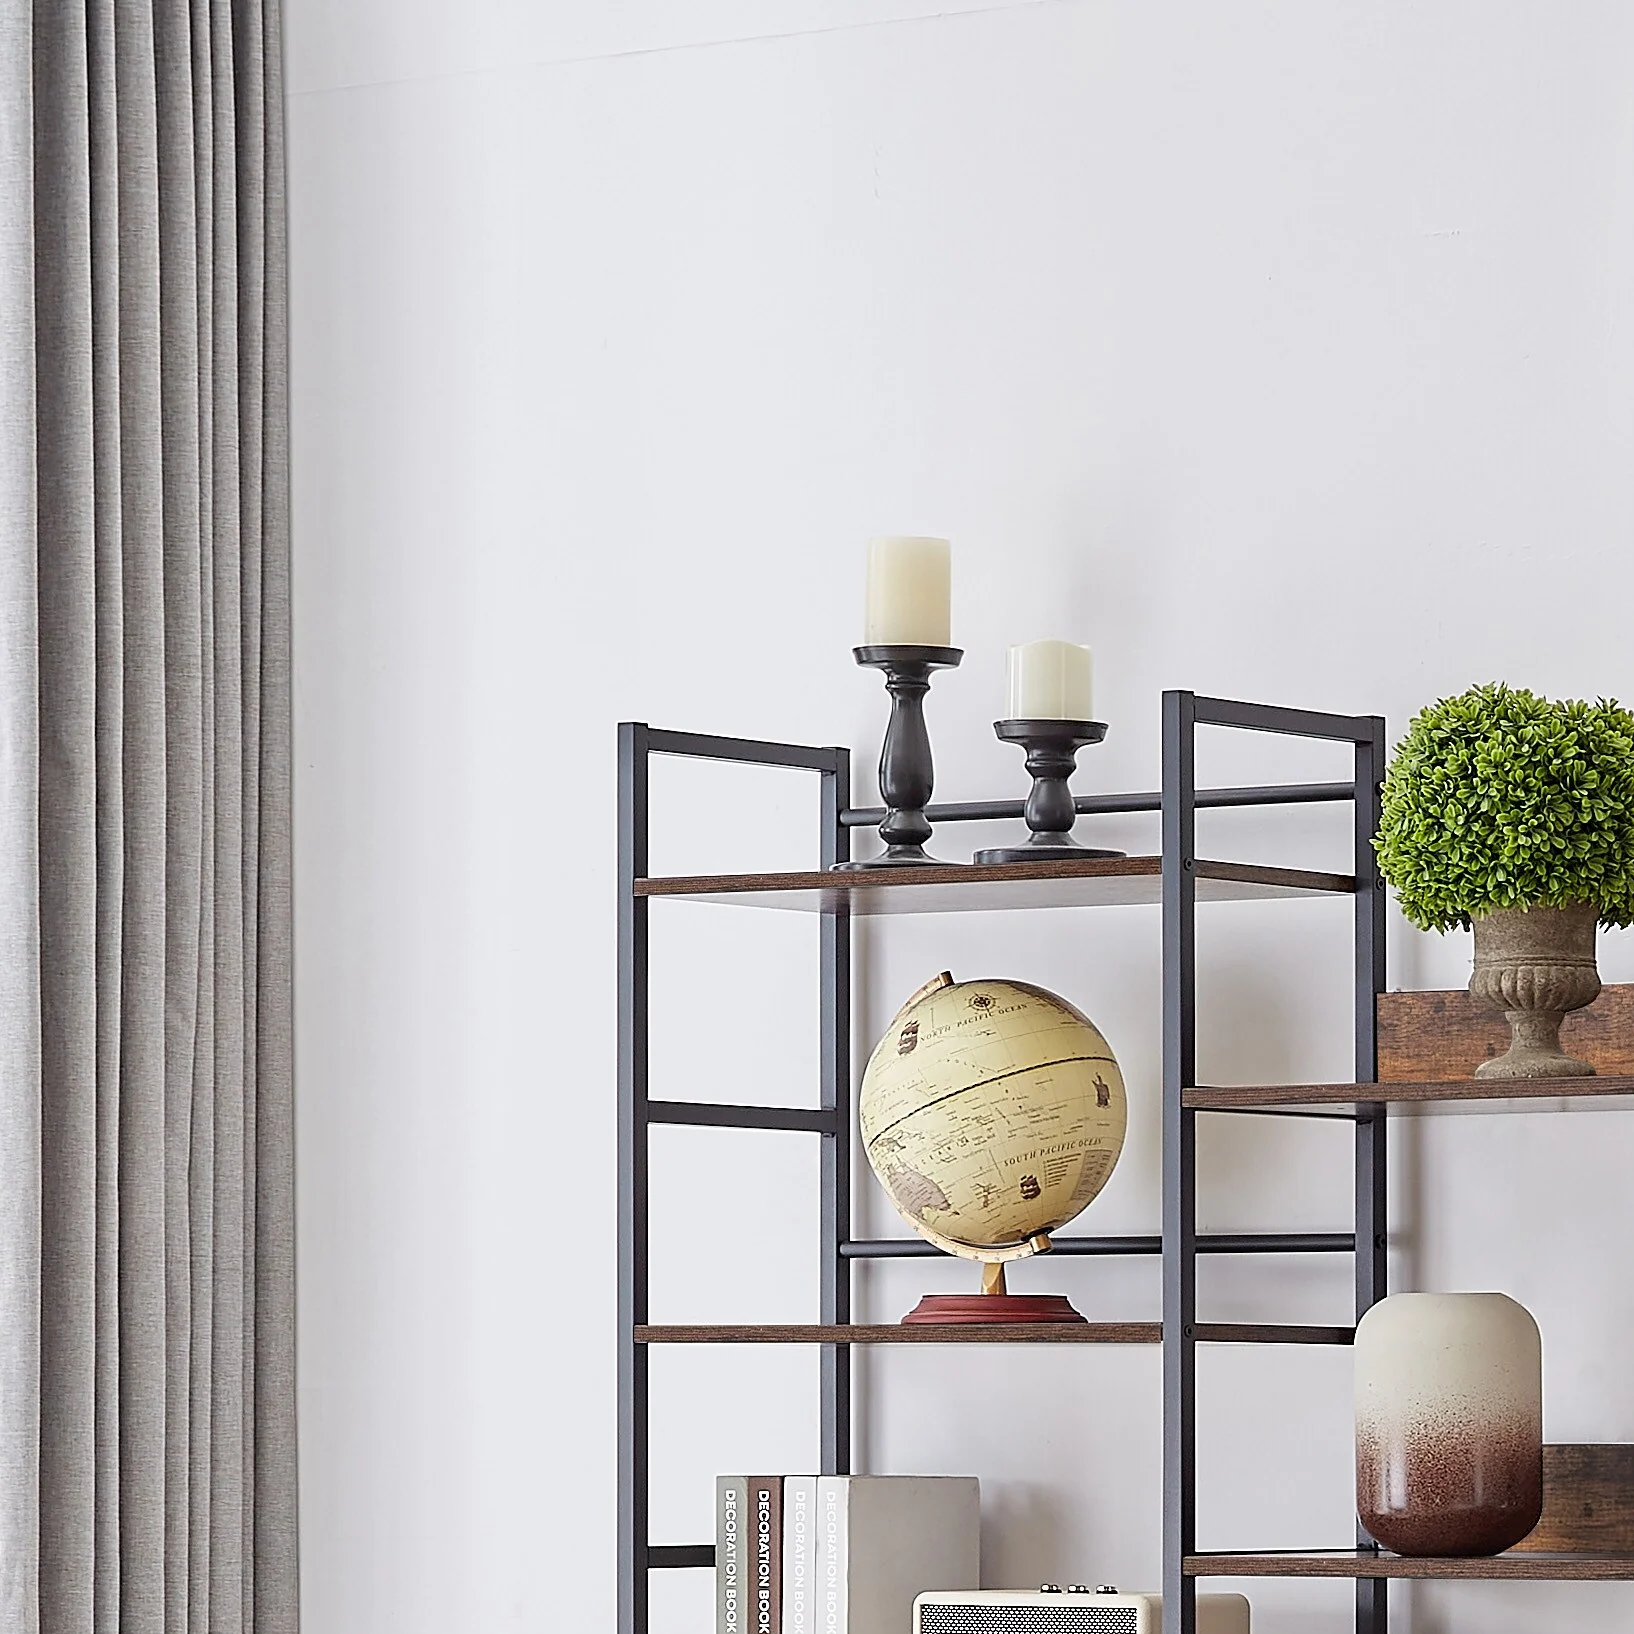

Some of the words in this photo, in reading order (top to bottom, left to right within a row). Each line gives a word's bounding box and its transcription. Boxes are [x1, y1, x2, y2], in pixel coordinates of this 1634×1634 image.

[957, 1011, 995, 1027] PACIFIC
[998, 1003, 1028, 1015] OCEAN
[1004, 1150, 1036, 1167] SOUTH
[1040, 1142, 1076, 1157] PACIFIC
[1078, 1137, 1102, 1147] OCEAN
[725, 1489, 737, 1586] DECORATION
[758, 1490, 770, 1587] DECORATION
[794, 1491, 806, 1588] DECORATION
[827, 1492, 836, 1588] DECORATION
[726, 1589, 737, 1633] BOOK
[758, 1590, 770, 1634] BOOK
[794, 1591, 805, 1634] BOOK
[826, 1591, 837, 1634] BOOK
